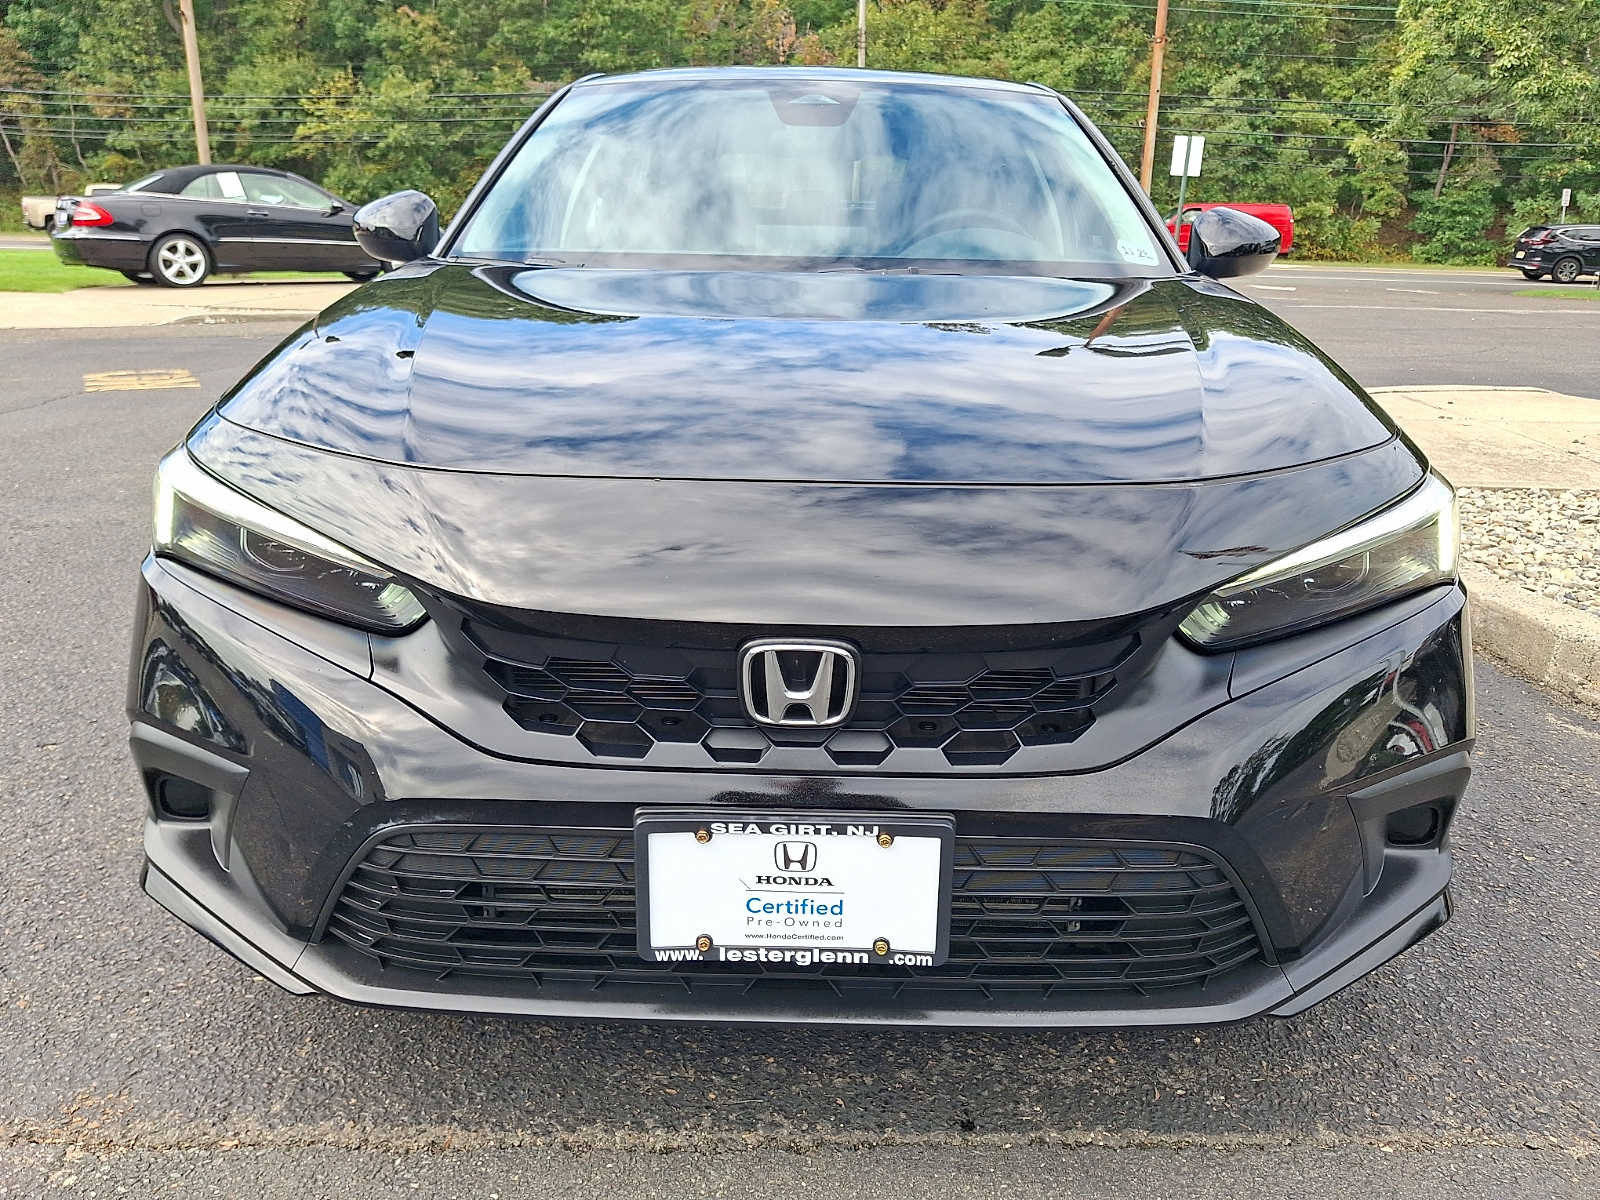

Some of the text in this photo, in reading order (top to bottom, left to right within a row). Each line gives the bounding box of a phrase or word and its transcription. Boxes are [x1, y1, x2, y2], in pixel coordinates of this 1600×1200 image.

[710, 823, 879, 837] SEA GIRT, NJ
[755, 875, 834, 887] HONDA
[746, 897, 843, 915] Certified
[746, 916, 843, 928] Pre-Owned
[744, 932, 844, 941] www.HondaCertified.com
[654, 947, 933, 967] www. lesterglenn .com
